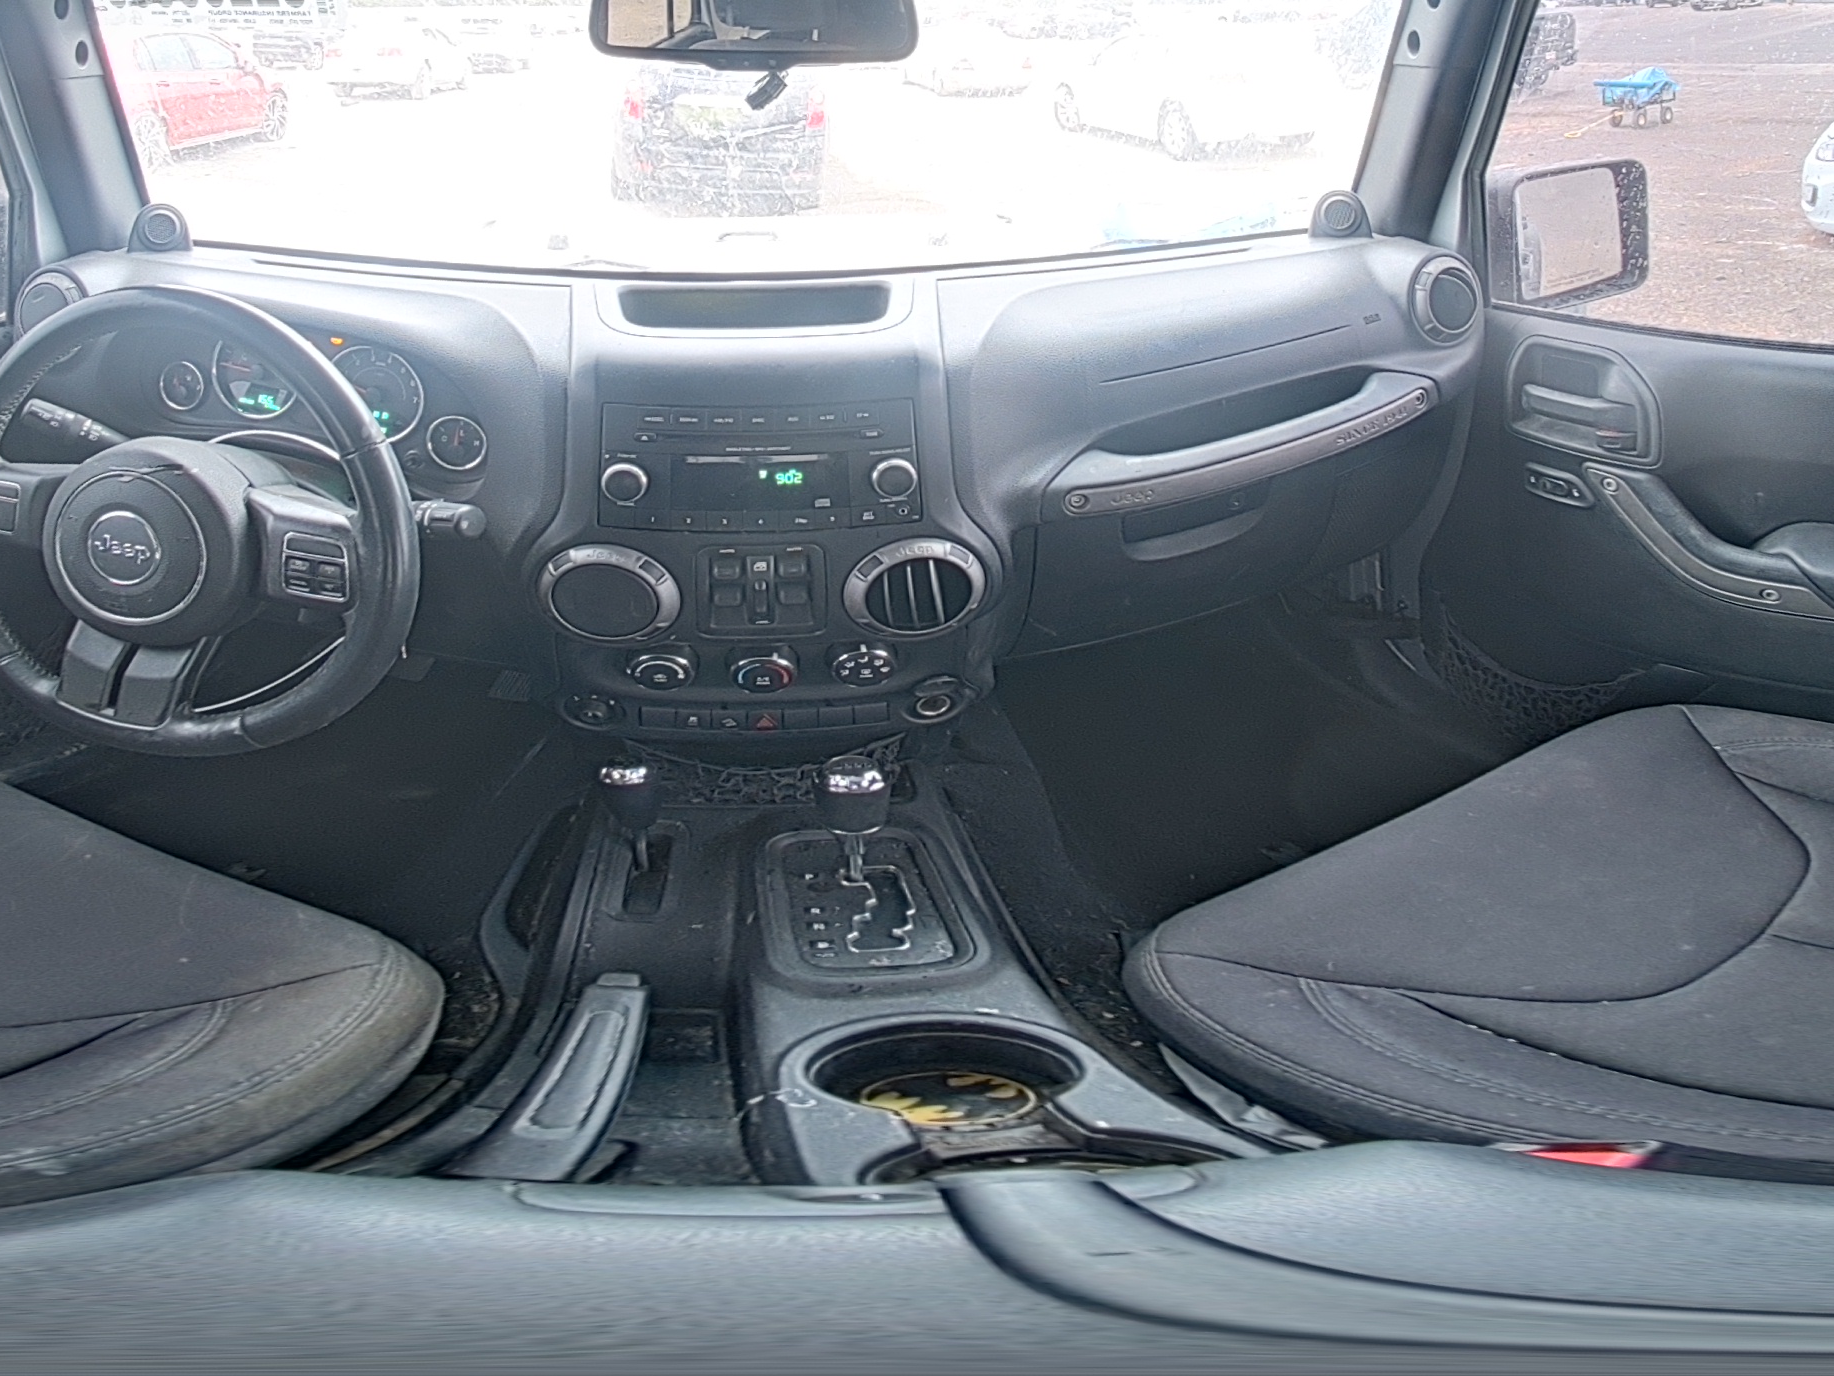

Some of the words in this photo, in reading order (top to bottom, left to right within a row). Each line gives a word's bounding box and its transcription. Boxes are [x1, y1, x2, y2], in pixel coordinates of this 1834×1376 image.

[1110, 488, 1154, 506] Jeep
[94, 534, 151, 565] Jeep
[895, 545, 934, 559] Jeep
